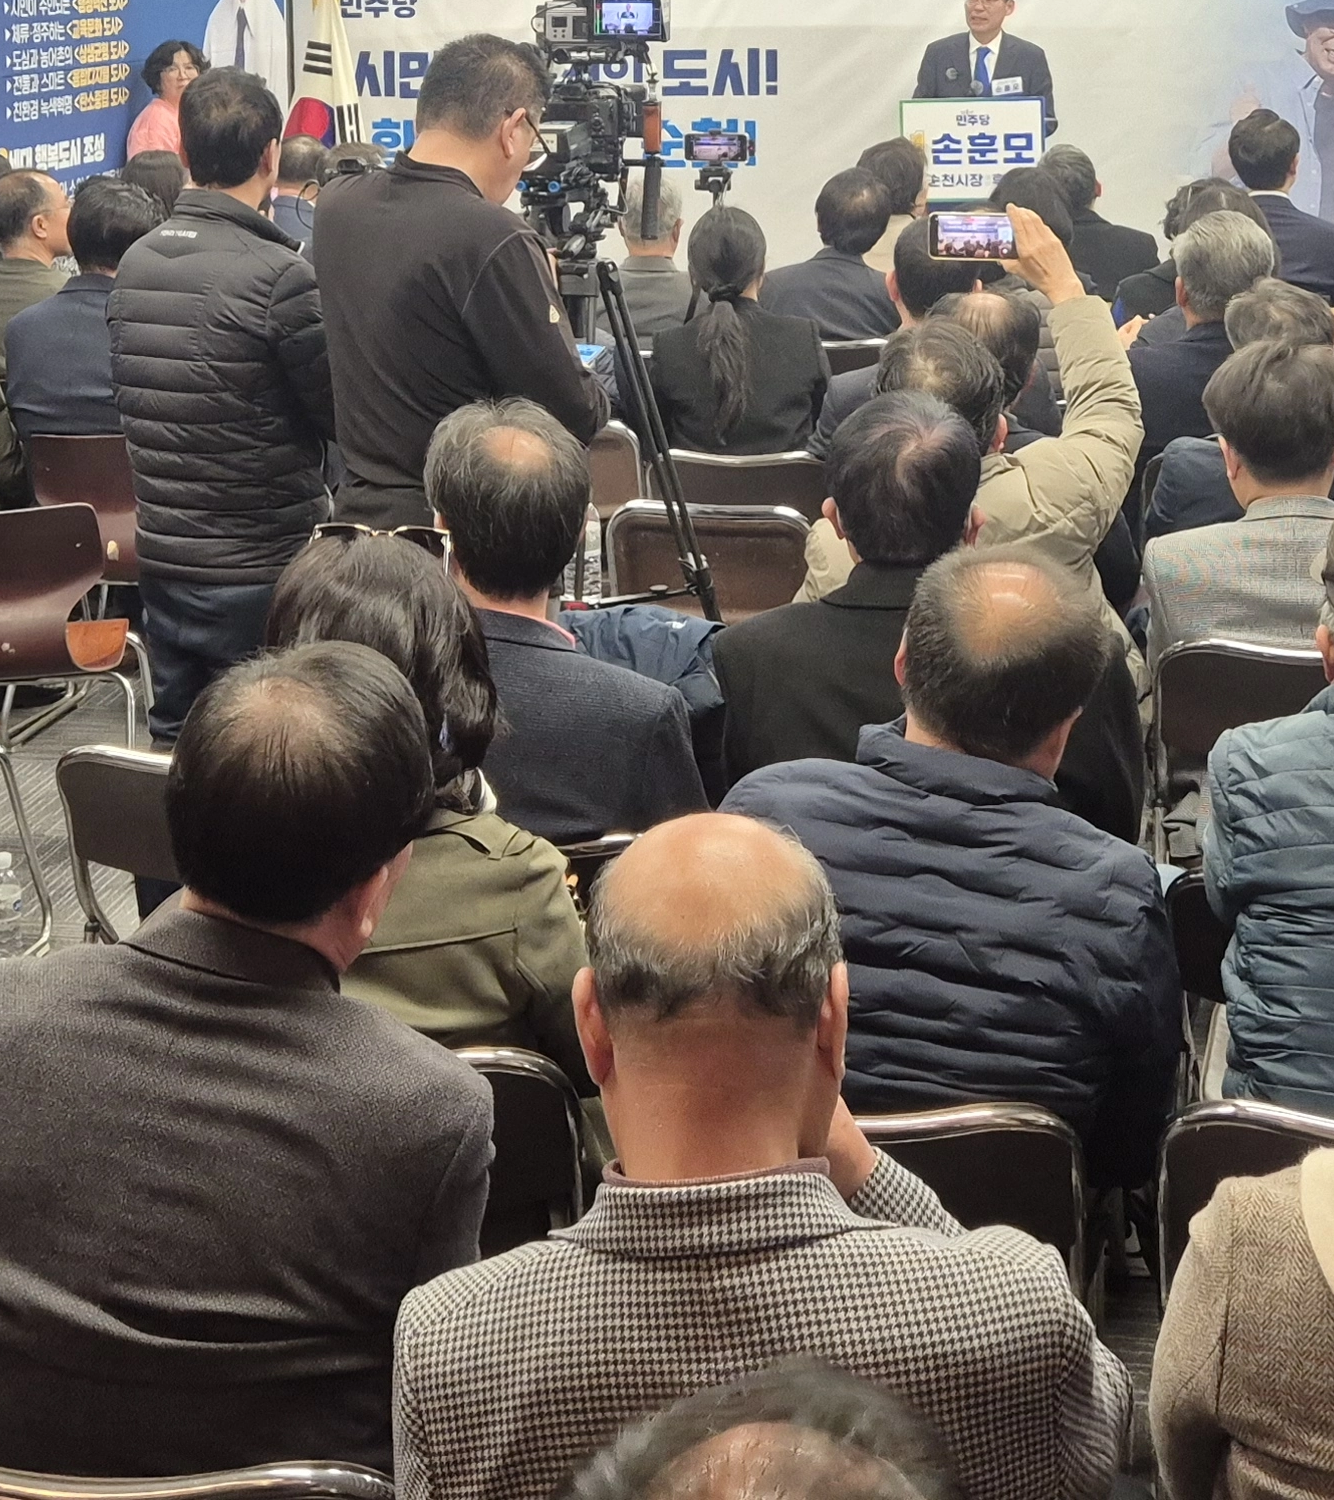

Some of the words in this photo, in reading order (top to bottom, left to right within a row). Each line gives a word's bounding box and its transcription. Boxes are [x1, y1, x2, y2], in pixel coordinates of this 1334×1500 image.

[12, 48, 39, 71] 도심과
[40, 45, 73, 68] 농어촌의
[12, 73, 39, 96] 전통과
[41, 71, 65, 92] 스마트
[661, 47, 778, 96] 도시!
[13, 99, 39, 122] 친환경
[40, 95, 73, 118] 녹색혁명
[956, 114, 990, 127] 민주당
[35, 137, 81, 171] 행복도시
[83, 133, 105, 164] 조성
[931, 132, 1035, 165] 손훈모
[928, 173, 984, 188] 순천시장
